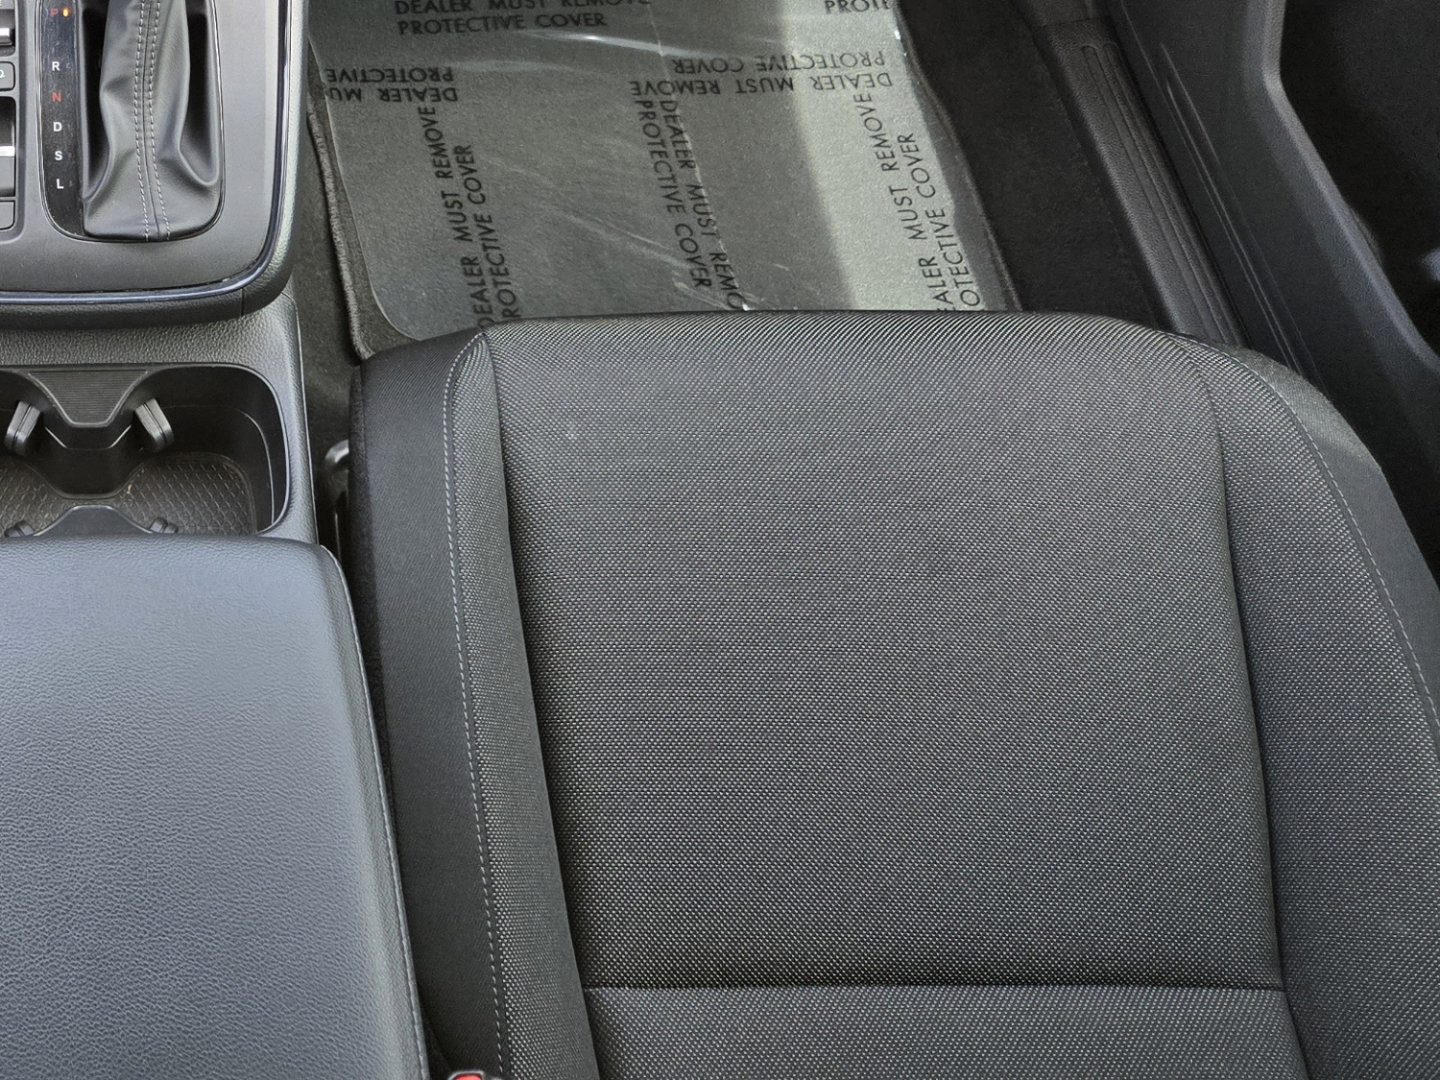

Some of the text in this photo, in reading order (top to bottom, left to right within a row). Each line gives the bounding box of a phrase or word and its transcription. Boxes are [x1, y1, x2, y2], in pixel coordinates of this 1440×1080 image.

[397, 10, 609, 36] PROTECTIVE COVER
[51, 61, 61, 71] R
[325, 66, 455, 84] PROTECTIVE
[670, 50, 887, 75] PROTECTIVE COVER
[51, 92, 62, 102] N
[378, 87, 459, 104] DEALER
[628, 71, 894, 97] DEALER MUST REMOVE
[53, 121, 63, 132] D
[852, 92, 901, 173] REMOVE
[54, 151, 63, 161] S
[417, 105, 455, 181] REMOVE
[658, 99, 698, 171] DEALER
[685, 182, 718, 238] MUST
[56, 179, 65, 189] L
[633, 98, 713, 289] PROTECTIVE COVER
[440, 190, 474, 244] MUST
[888, 184, 928, 241] MUST
[896, 132, 982, 308] OTECTIVE COVER
[452, 143, 522, 320] ROTECTIVE COVER
